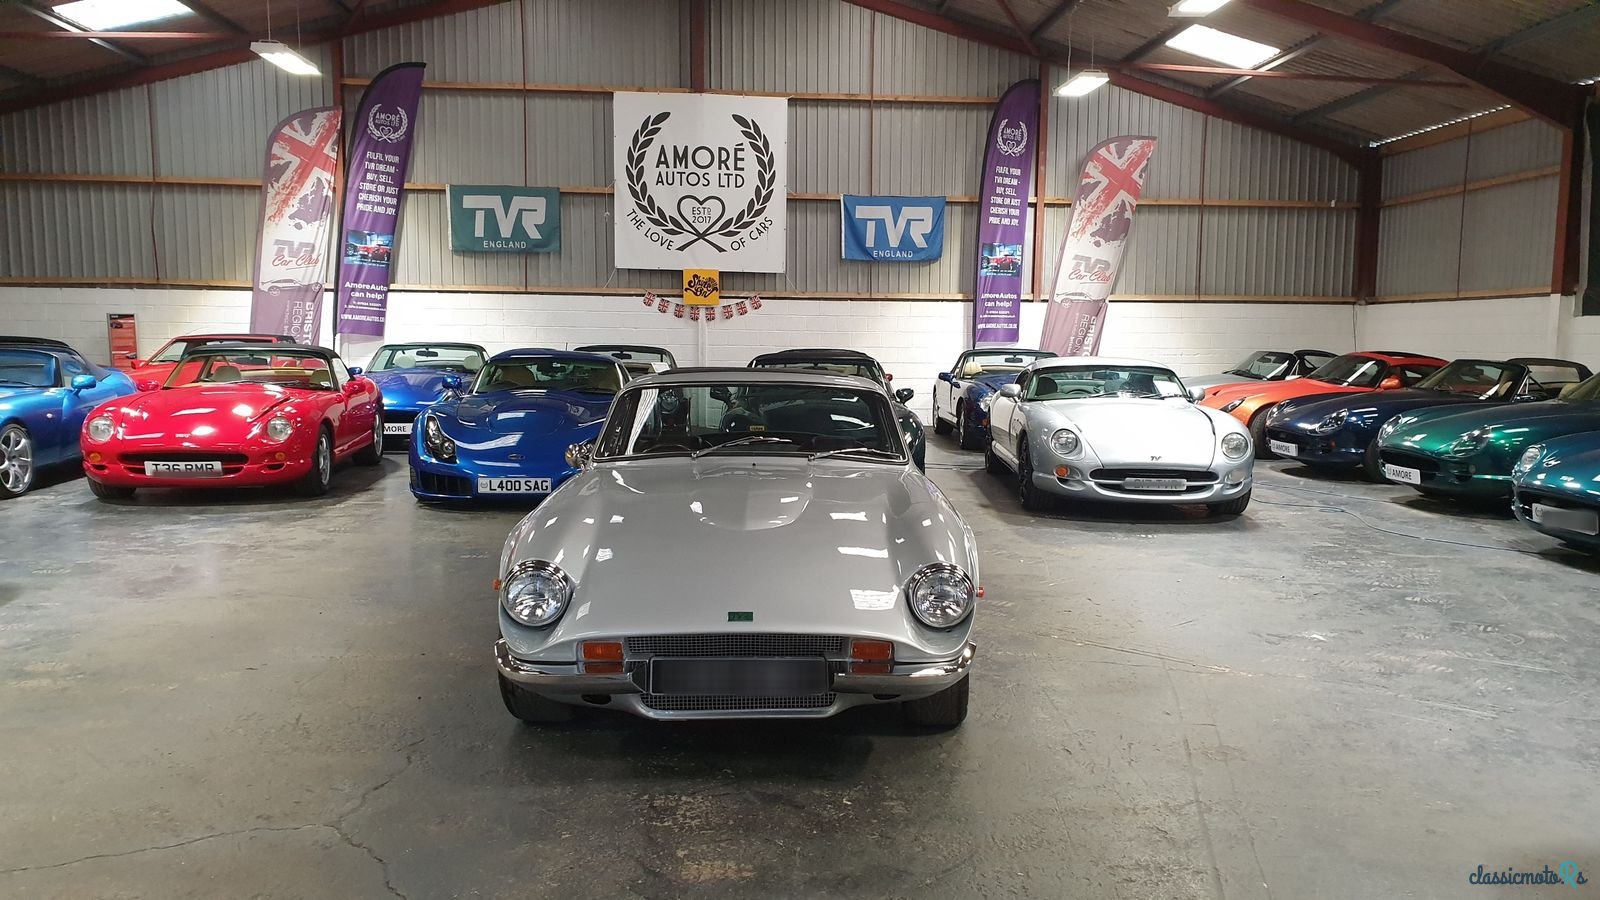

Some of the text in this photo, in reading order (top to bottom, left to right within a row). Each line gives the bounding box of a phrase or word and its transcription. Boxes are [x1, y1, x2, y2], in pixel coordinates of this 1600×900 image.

[367, 151, 399, 163] FULFIL YOUR
[656, 143, 745, 171] AMORÉ
[365, 162, 375, 170] TVR
[376, 164, 395, 173] DREAM
[996, 166, 1021, 176] FULFIL YOUR
[366, 173, 394, 184] BUY, SELL,
[656, 172, 744, 188] AUTOS LTD
[1003, 177, 1018, 185] DREAM
[359, 182, 376, 191] STORE
[386, 186, 399, 194] JUST
[358, 193, 397, 205] CHERISH YOUR
[991, 196, 1003, 204] STORE
[356, 203, 372, 212] PRIDE
[374, 205, 385, 214] AND
[463, 195, 546, 239] TVR
[626, 208, 773, 251] THE LOVE OF CARS
[856, 206, 933, 248] TVR
[484, 240, 526, 249] ENGLAND
[272, 253, 322, 266] Car Club
[873, 250, 913, 258] ENGLAND
[1069, 269, 1114, 281] Car Club
[344, 282, 387, 291] AmoreAuto
[366, 292, 384, 300] help!
[1392, 469, 1411, 480] AMORE
[489, 480, 548, 491] L400 SAG
